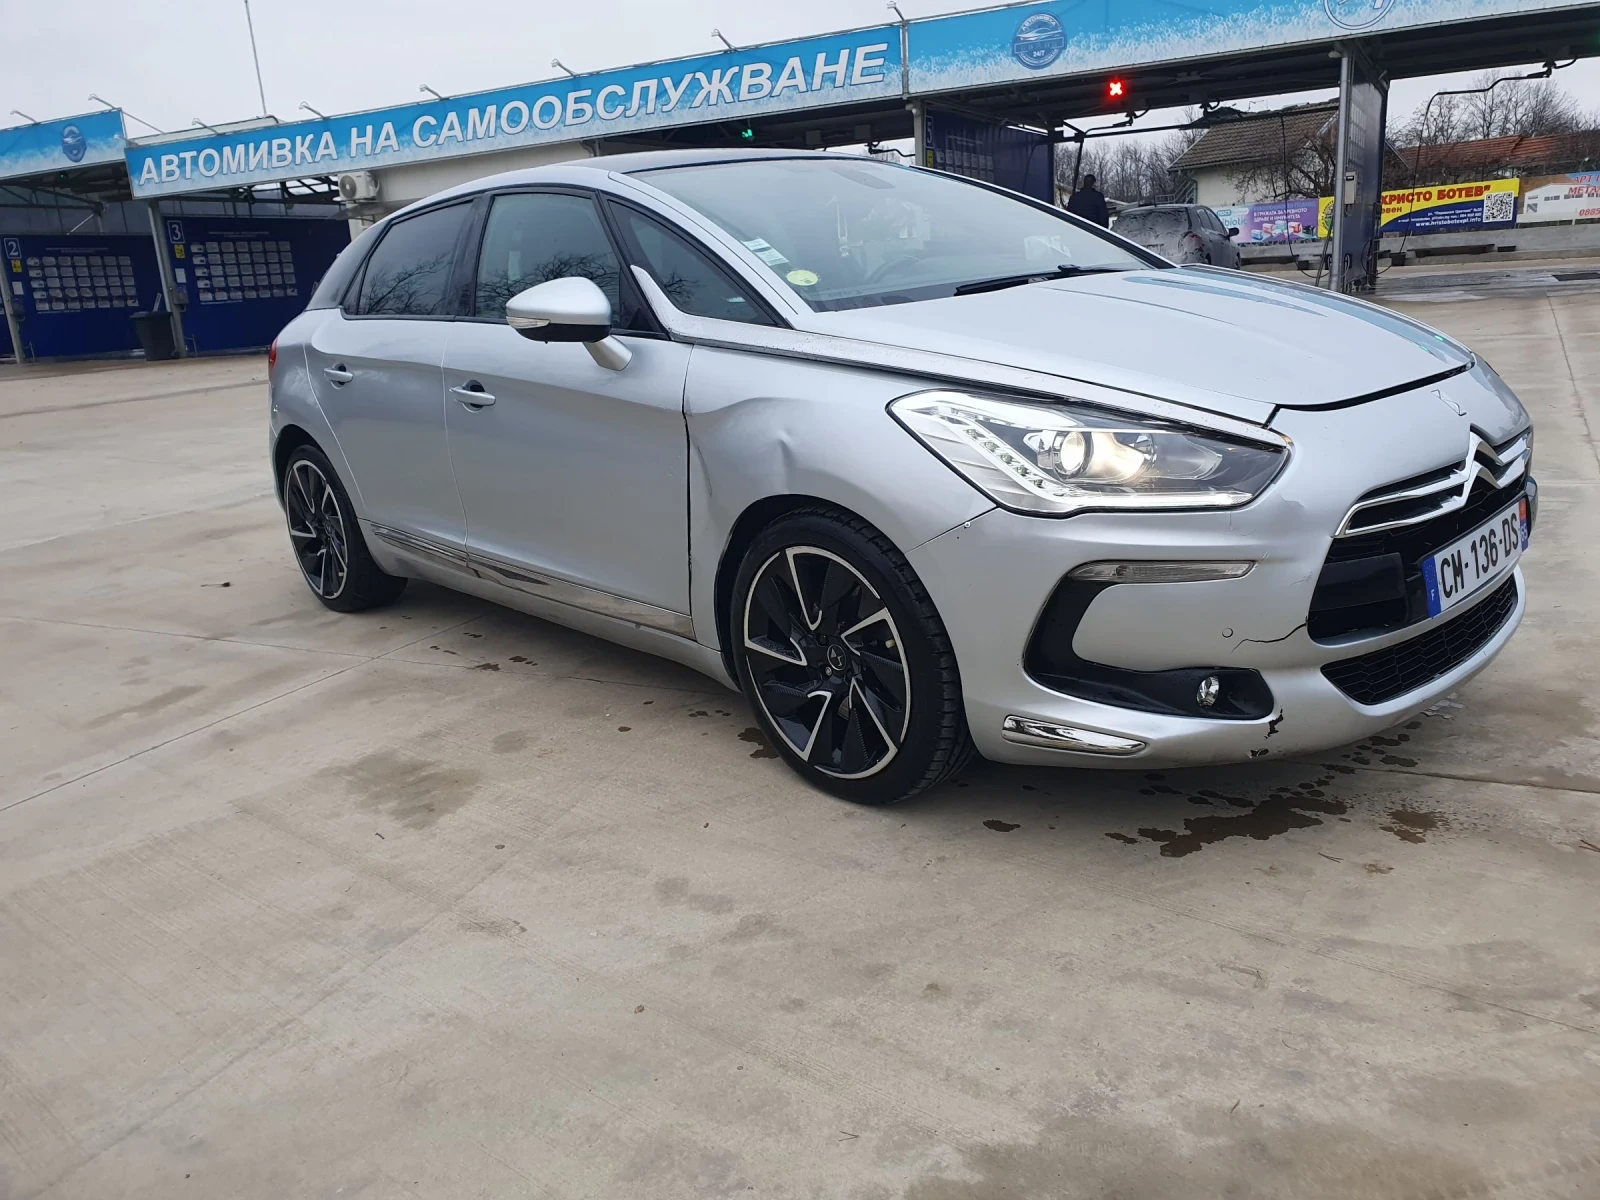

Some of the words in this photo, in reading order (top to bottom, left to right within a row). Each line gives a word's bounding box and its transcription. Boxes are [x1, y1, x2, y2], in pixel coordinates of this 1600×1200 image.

[139, 131, 338, 186] АВТОМИВКА
[350, 121, 399, 158] НА
[412, 42, 889, 148] САМООБСЛУЖВАНЕ
[1382, 191, 1433, 206] ХРИСТО
[171, 224, 182, 240] 3
[8, 241, 19, 256] 2
